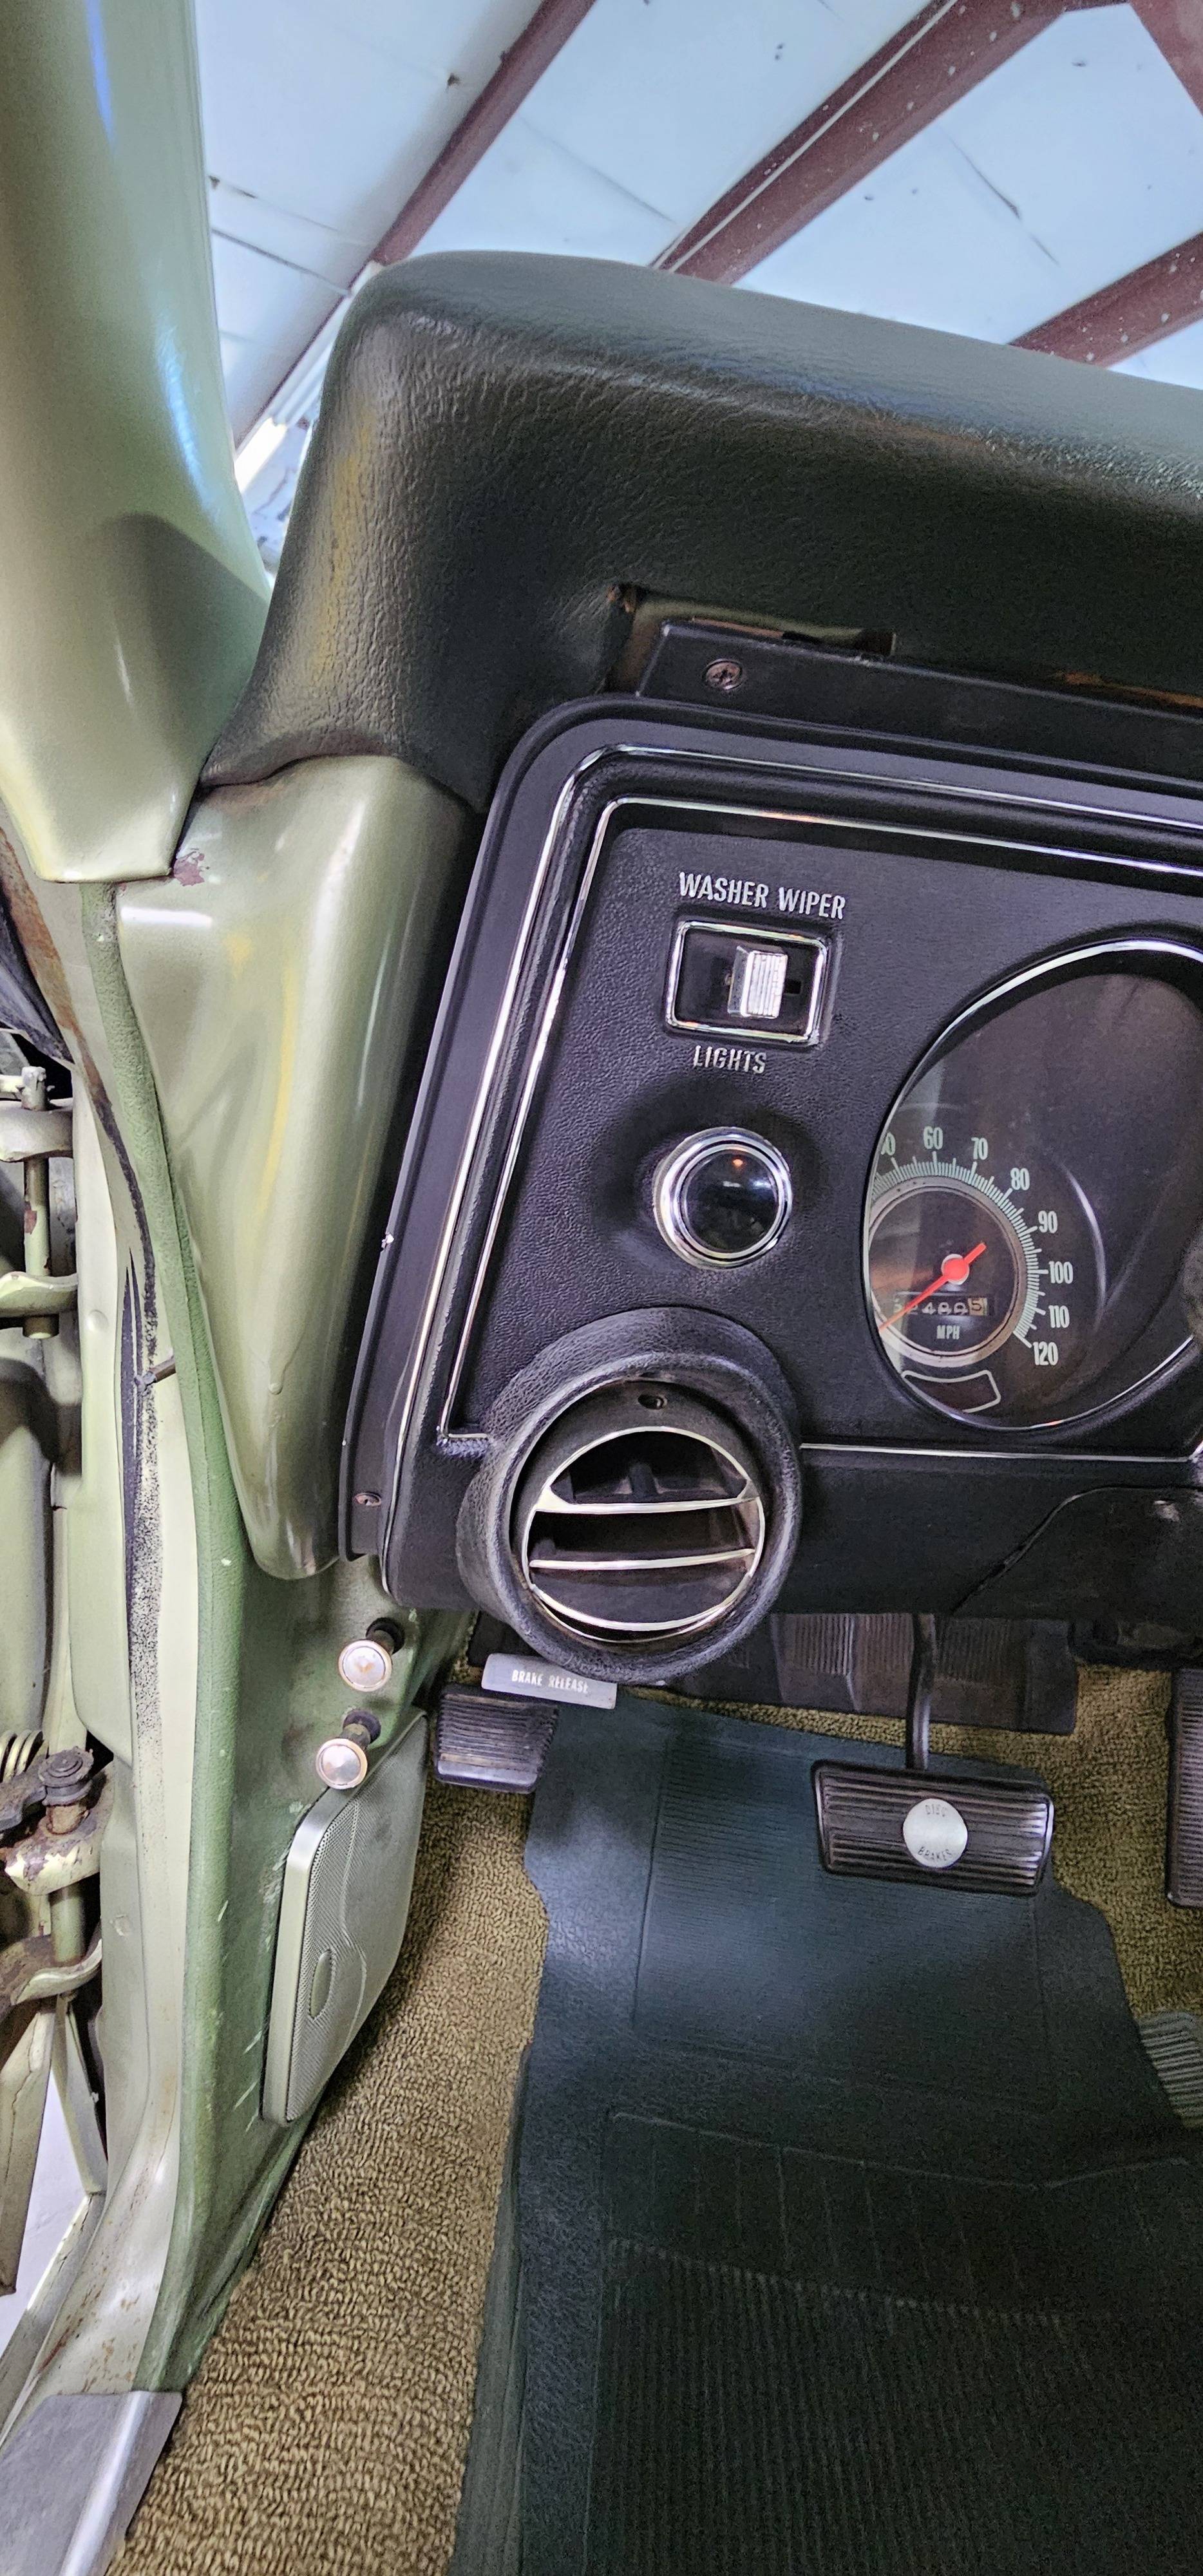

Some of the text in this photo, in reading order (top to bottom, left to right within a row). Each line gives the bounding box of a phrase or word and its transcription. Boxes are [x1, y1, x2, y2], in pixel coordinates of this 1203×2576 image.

[679, 871, 846, 920] WASHER WIPER
[693, 1045, 767, 1074] LIGHTS
[924, 1126, 943, 1150] 60
[971, 1137, 989, 1160] 70
[1010, 1168, 1030, 1191] 80
[1038, 1211, 1058, 1233] 90
[1048, 1261, 1073, 1284] 100
[1048, 1305, 1070, 1329] 110
[936, 1325, 960, 1340] MPH
[1033, 1341, 1059, 1365] 120
[511, 1669, 589, 1694] BRAKE RELEASE
